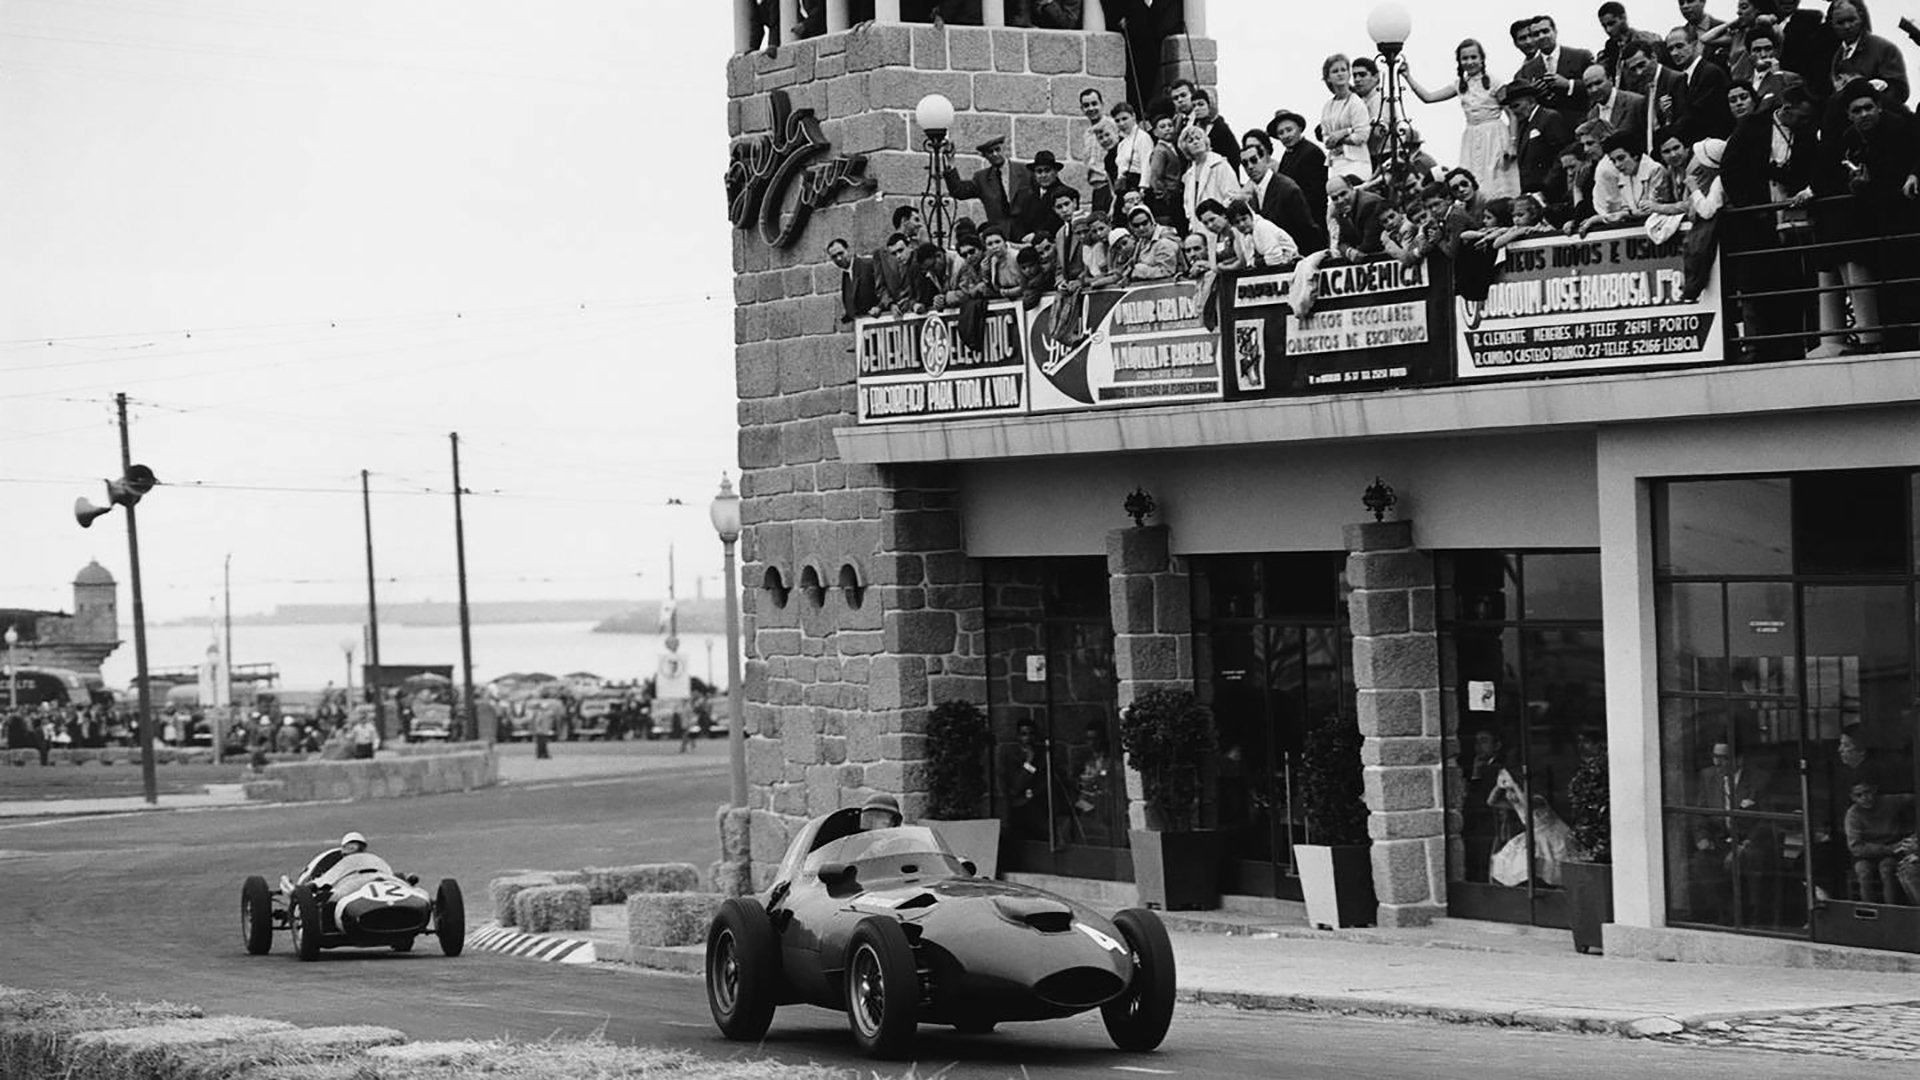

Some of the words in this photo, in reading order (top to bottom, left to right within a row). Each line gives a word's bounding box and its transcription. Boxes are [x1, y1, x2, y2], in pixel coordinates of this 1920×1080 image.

[1553, 243, 1602, 268] NOVOS
[1610, 241, 1621, 264] E
[1480, 280, 1543, 318] JOAQUIM
[1543, 270, 1580, 312] JOSÉ
[1580, 271, 1651, 309] BARBOSA
[1659, 316, 1699, 332] PORTO
[862, 324, 920, 372] GENERAL
[1346, 332, 1358, 348] DE
[1514, 347, 1551, 362] CASTELO
[984, 377, 993, 408] A
[992, 375, 1019, 407] VIDA
[369, 883, 404, 897] 12
[1074, 922, 1128, 955] 4
